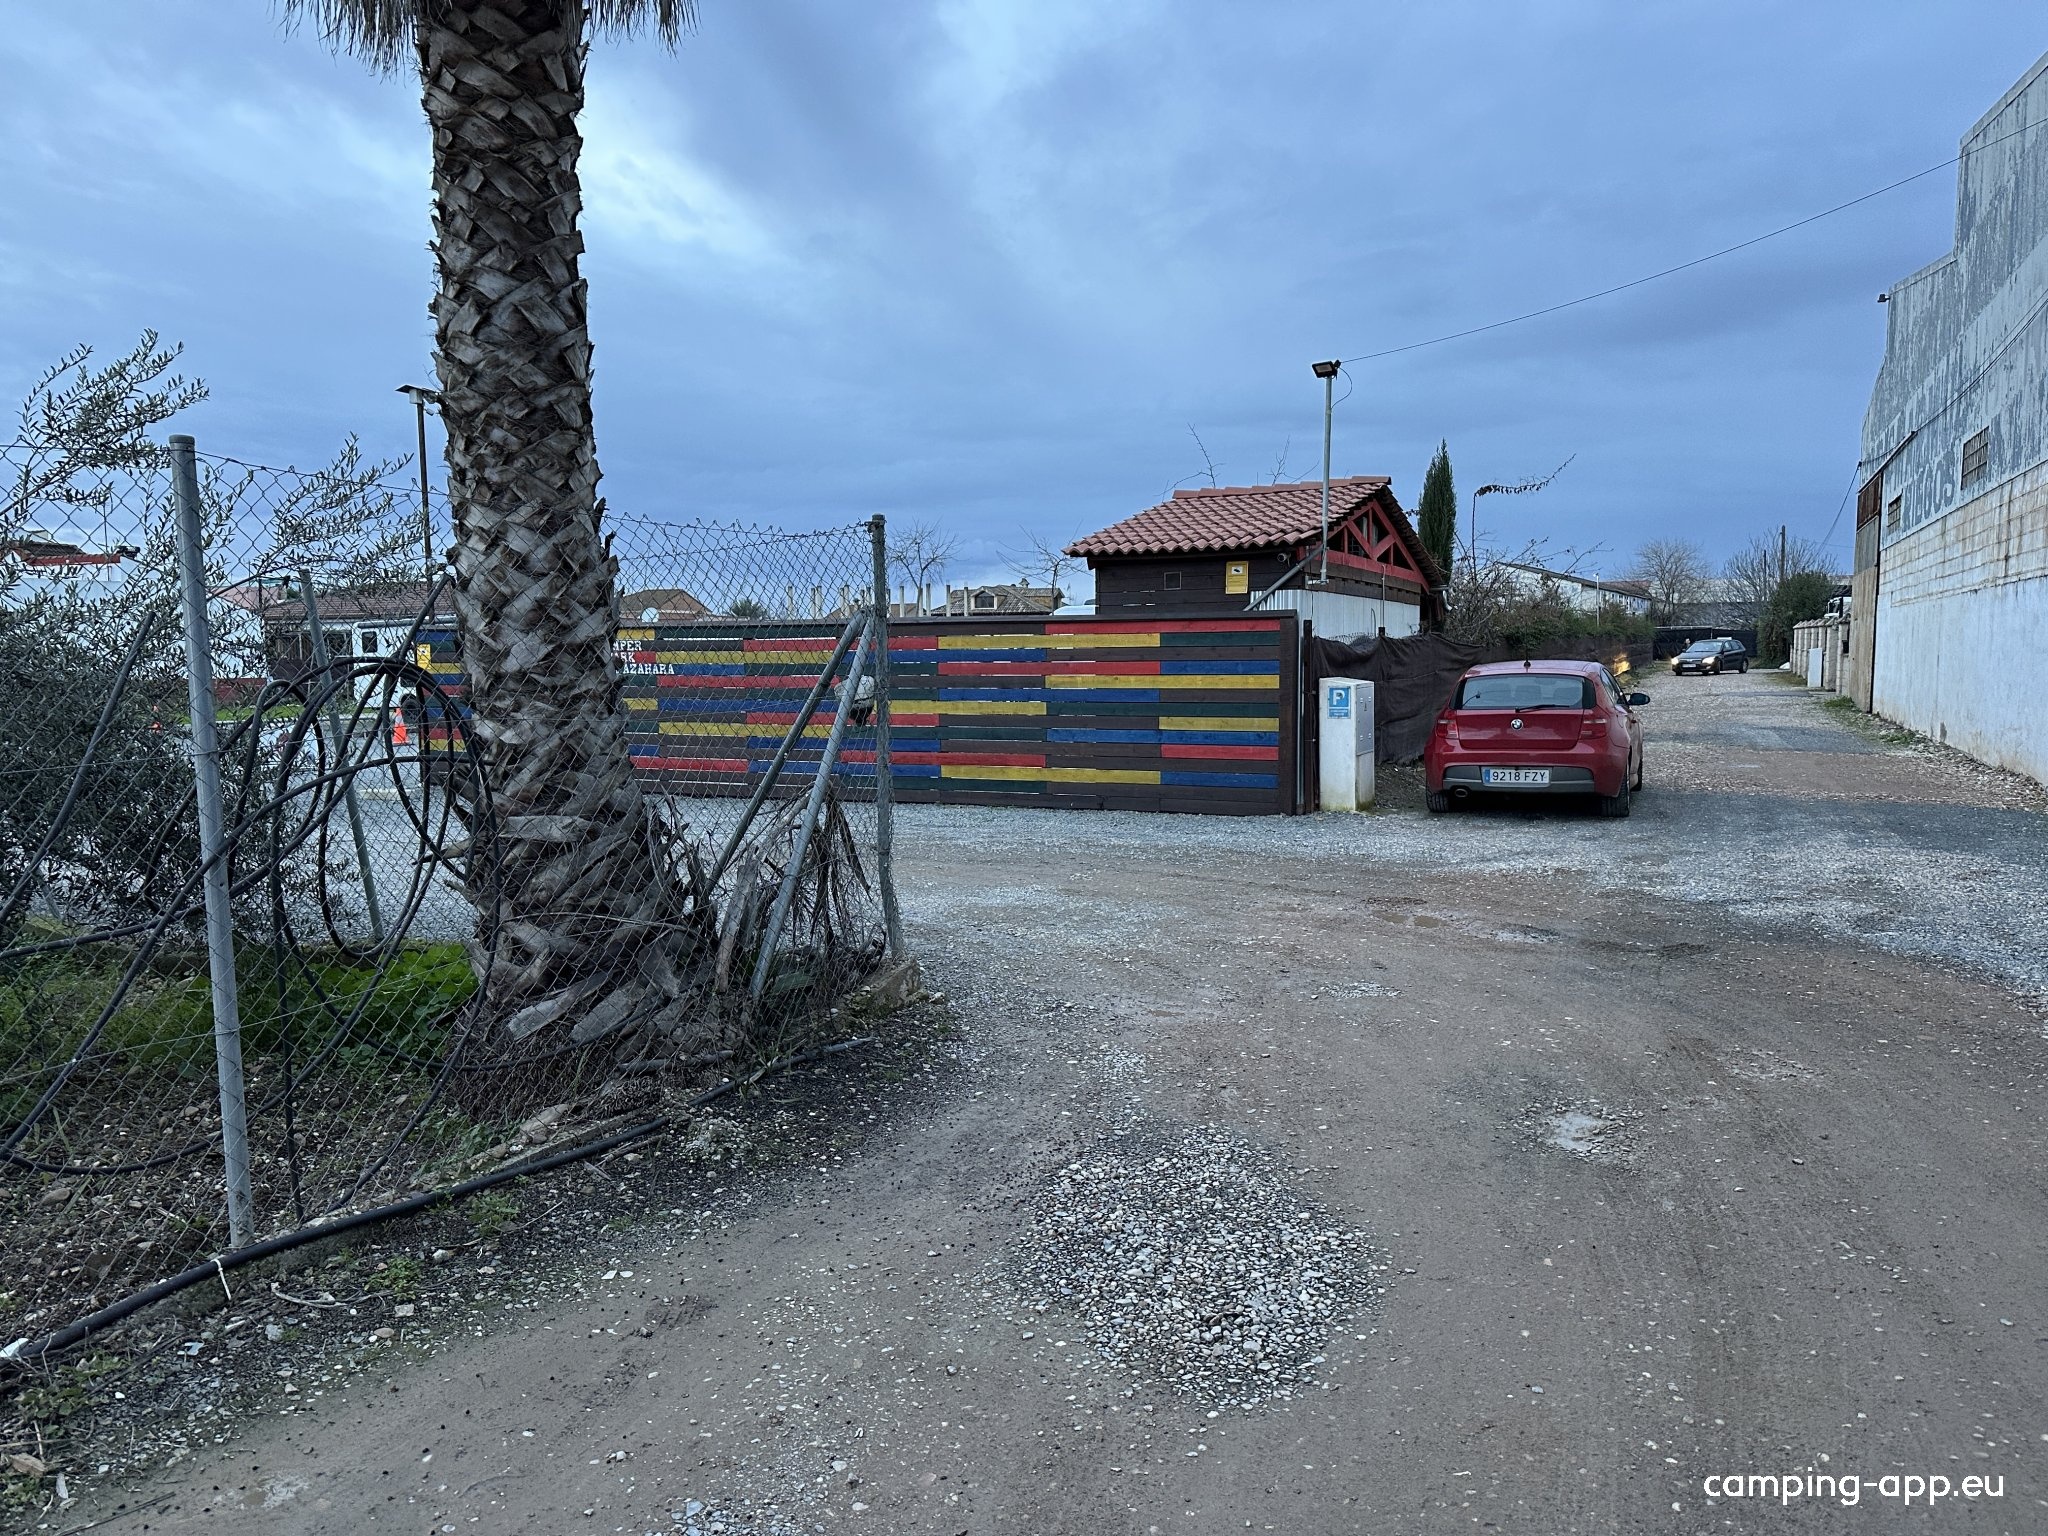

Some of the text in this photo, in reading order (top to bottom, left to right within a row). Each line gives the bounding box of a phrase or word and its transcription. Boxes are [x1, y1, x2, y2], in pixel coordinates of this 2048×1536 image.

[1332, 689, 1346, 706] P
[1492, 771, 1546, 782] 9218 FZY
